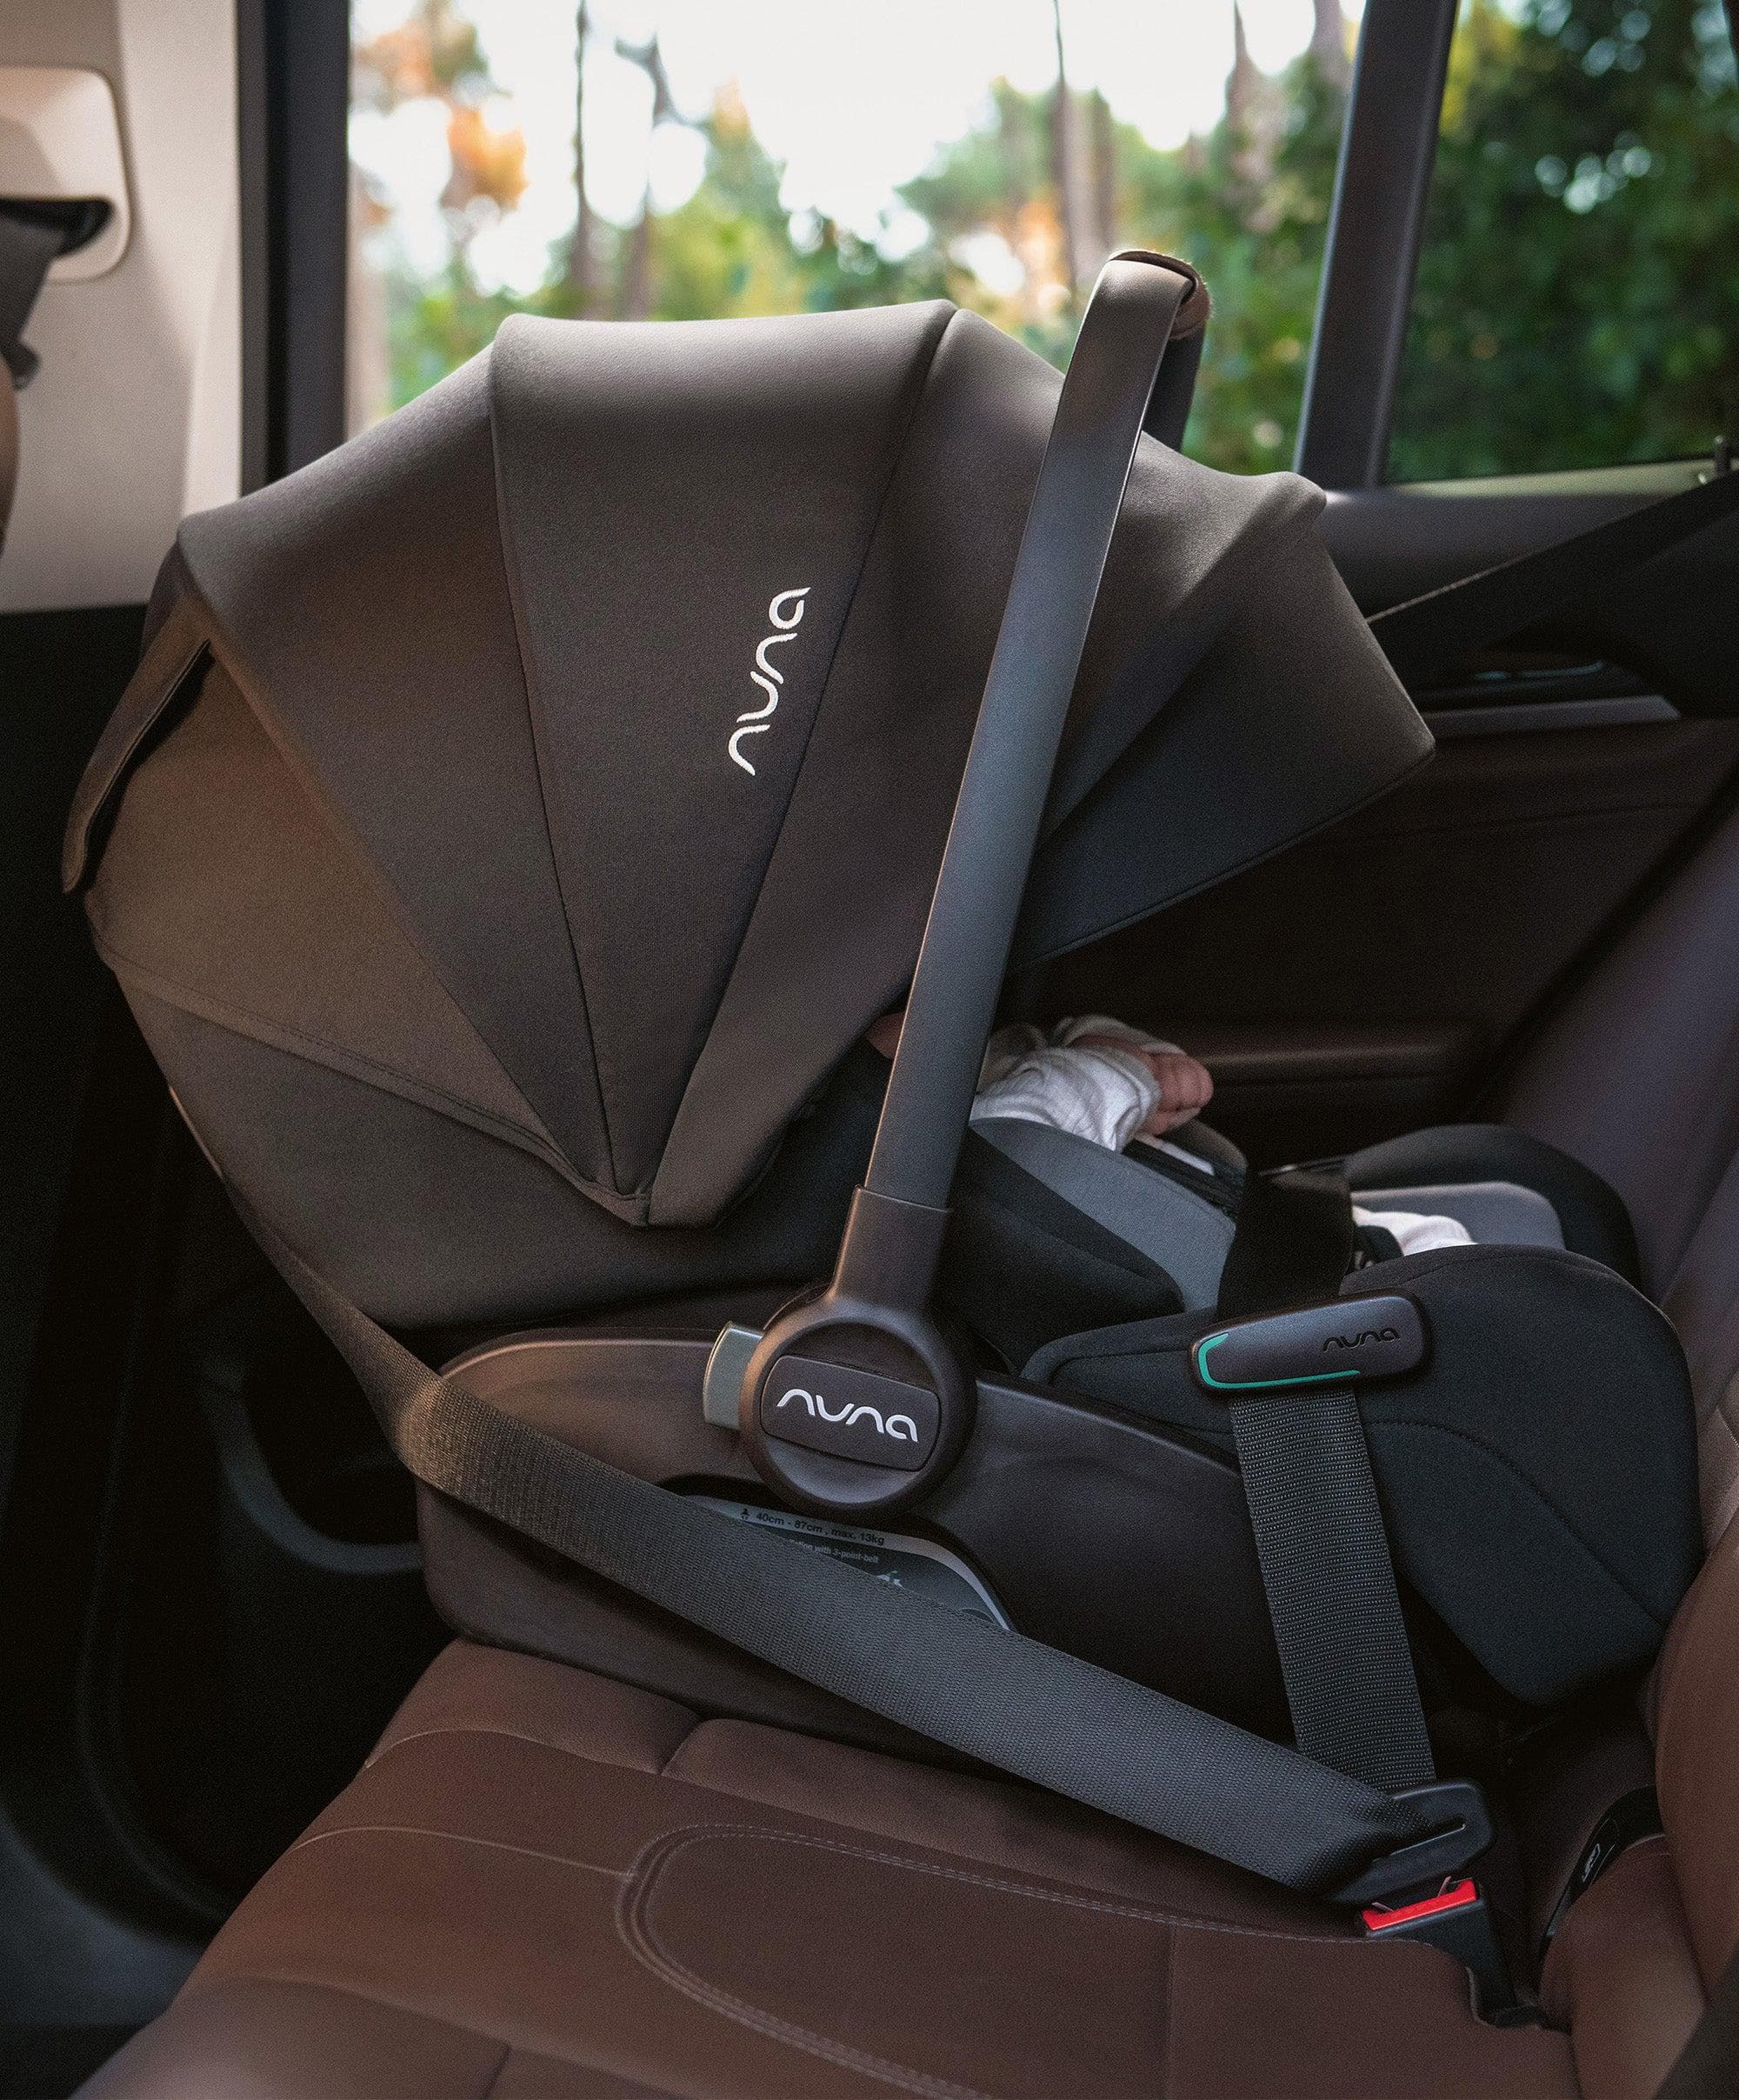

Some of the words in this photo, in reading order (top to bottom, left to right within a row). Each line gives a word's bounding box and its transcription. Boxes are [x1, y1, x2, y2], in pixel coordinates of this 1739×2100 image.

[728, 586, 811, 777] nuna
[1323, 1327, 1401, 1353] nuna
[776, 1389, 919, 1443] nuna
[756, 1512, 784, 1526] 40cm
[794, 1519, 823, 1533] 87cm
[859, 1532, 885, 1546] 13kg
